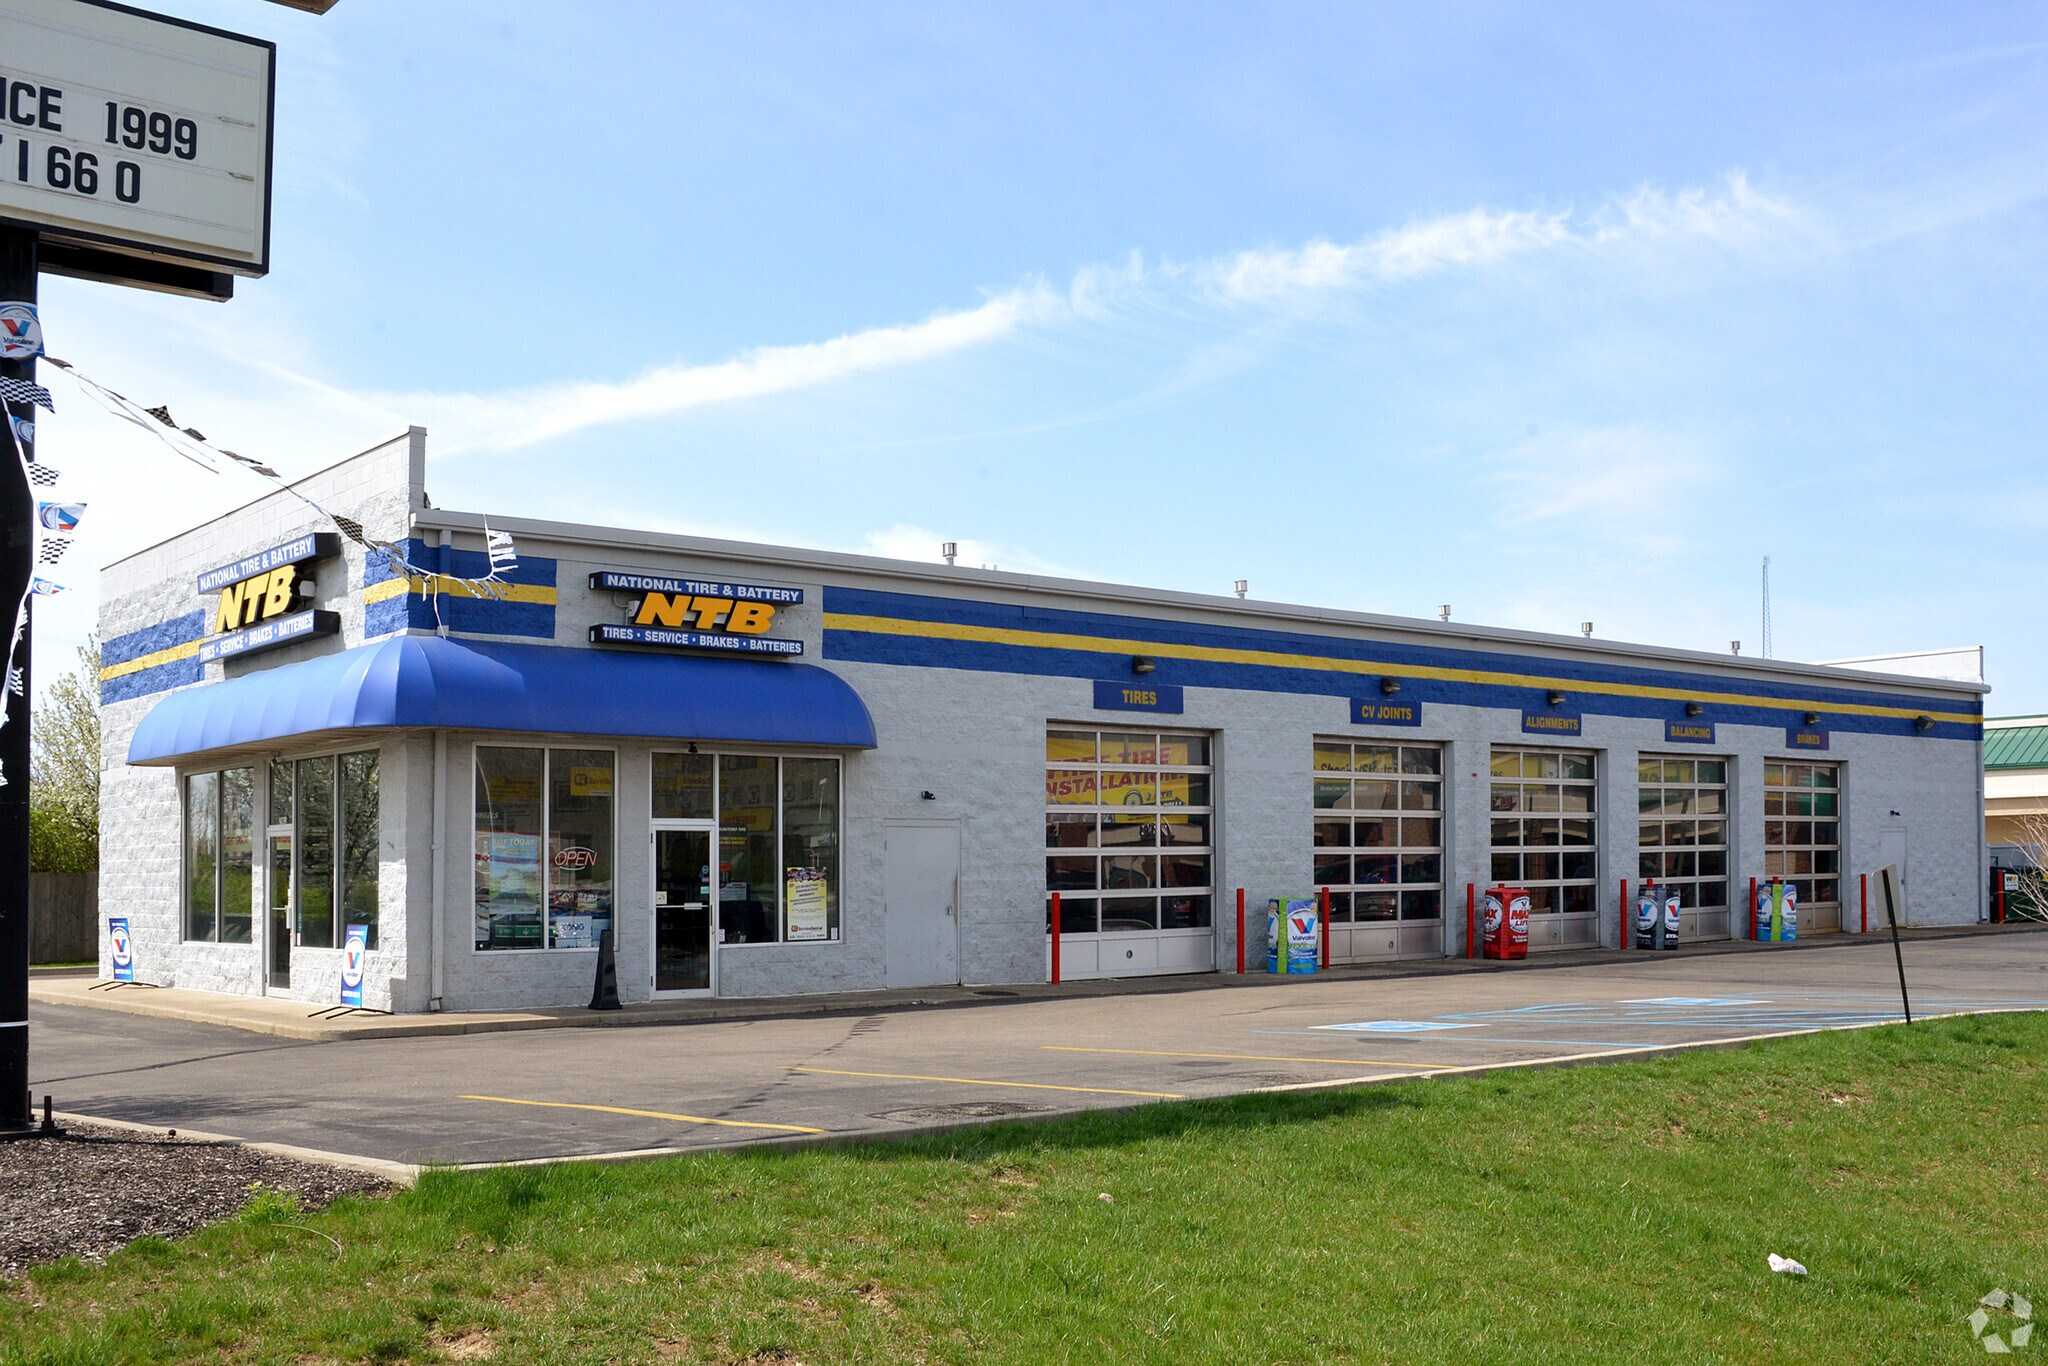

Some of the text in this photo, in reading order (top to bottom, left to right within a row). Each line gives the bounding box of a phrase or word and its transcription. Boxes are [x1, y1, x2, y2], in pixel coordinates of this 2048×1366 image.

[0, 77, 197, 160] CE 1999
[200, 537, 313, 591] NATIONAL TIRE & BATTERY
[215, 564, 296, 634] NTB
[607, 574, 800, 602] NATIONAL TIRE & BATTERY
[635, 592, 776, 635] NTB
[200, 613, 313, 662] TIRES SERVICE BRAKES BATTERIES
[602, 626, 802, 653] TIRES SERVICE BRAKES BATTERIES
[1122, 689, 1157, 706] TIRES
[1361, 705, 1413, 720] CV JOINTS
[1525, 715, 1579, 731] ALIGNMENTS
[1670, 725, 1711, 739] BALANCING
[1797, 734, 1821, 745] BRAKES
[1117, 747, 1170, 767] TIRE
[1046, 772, 1184, 797] NSTALLATION!
[493, 838, 508, 846] BUY
[555, 851, 598, 866] OPEN
